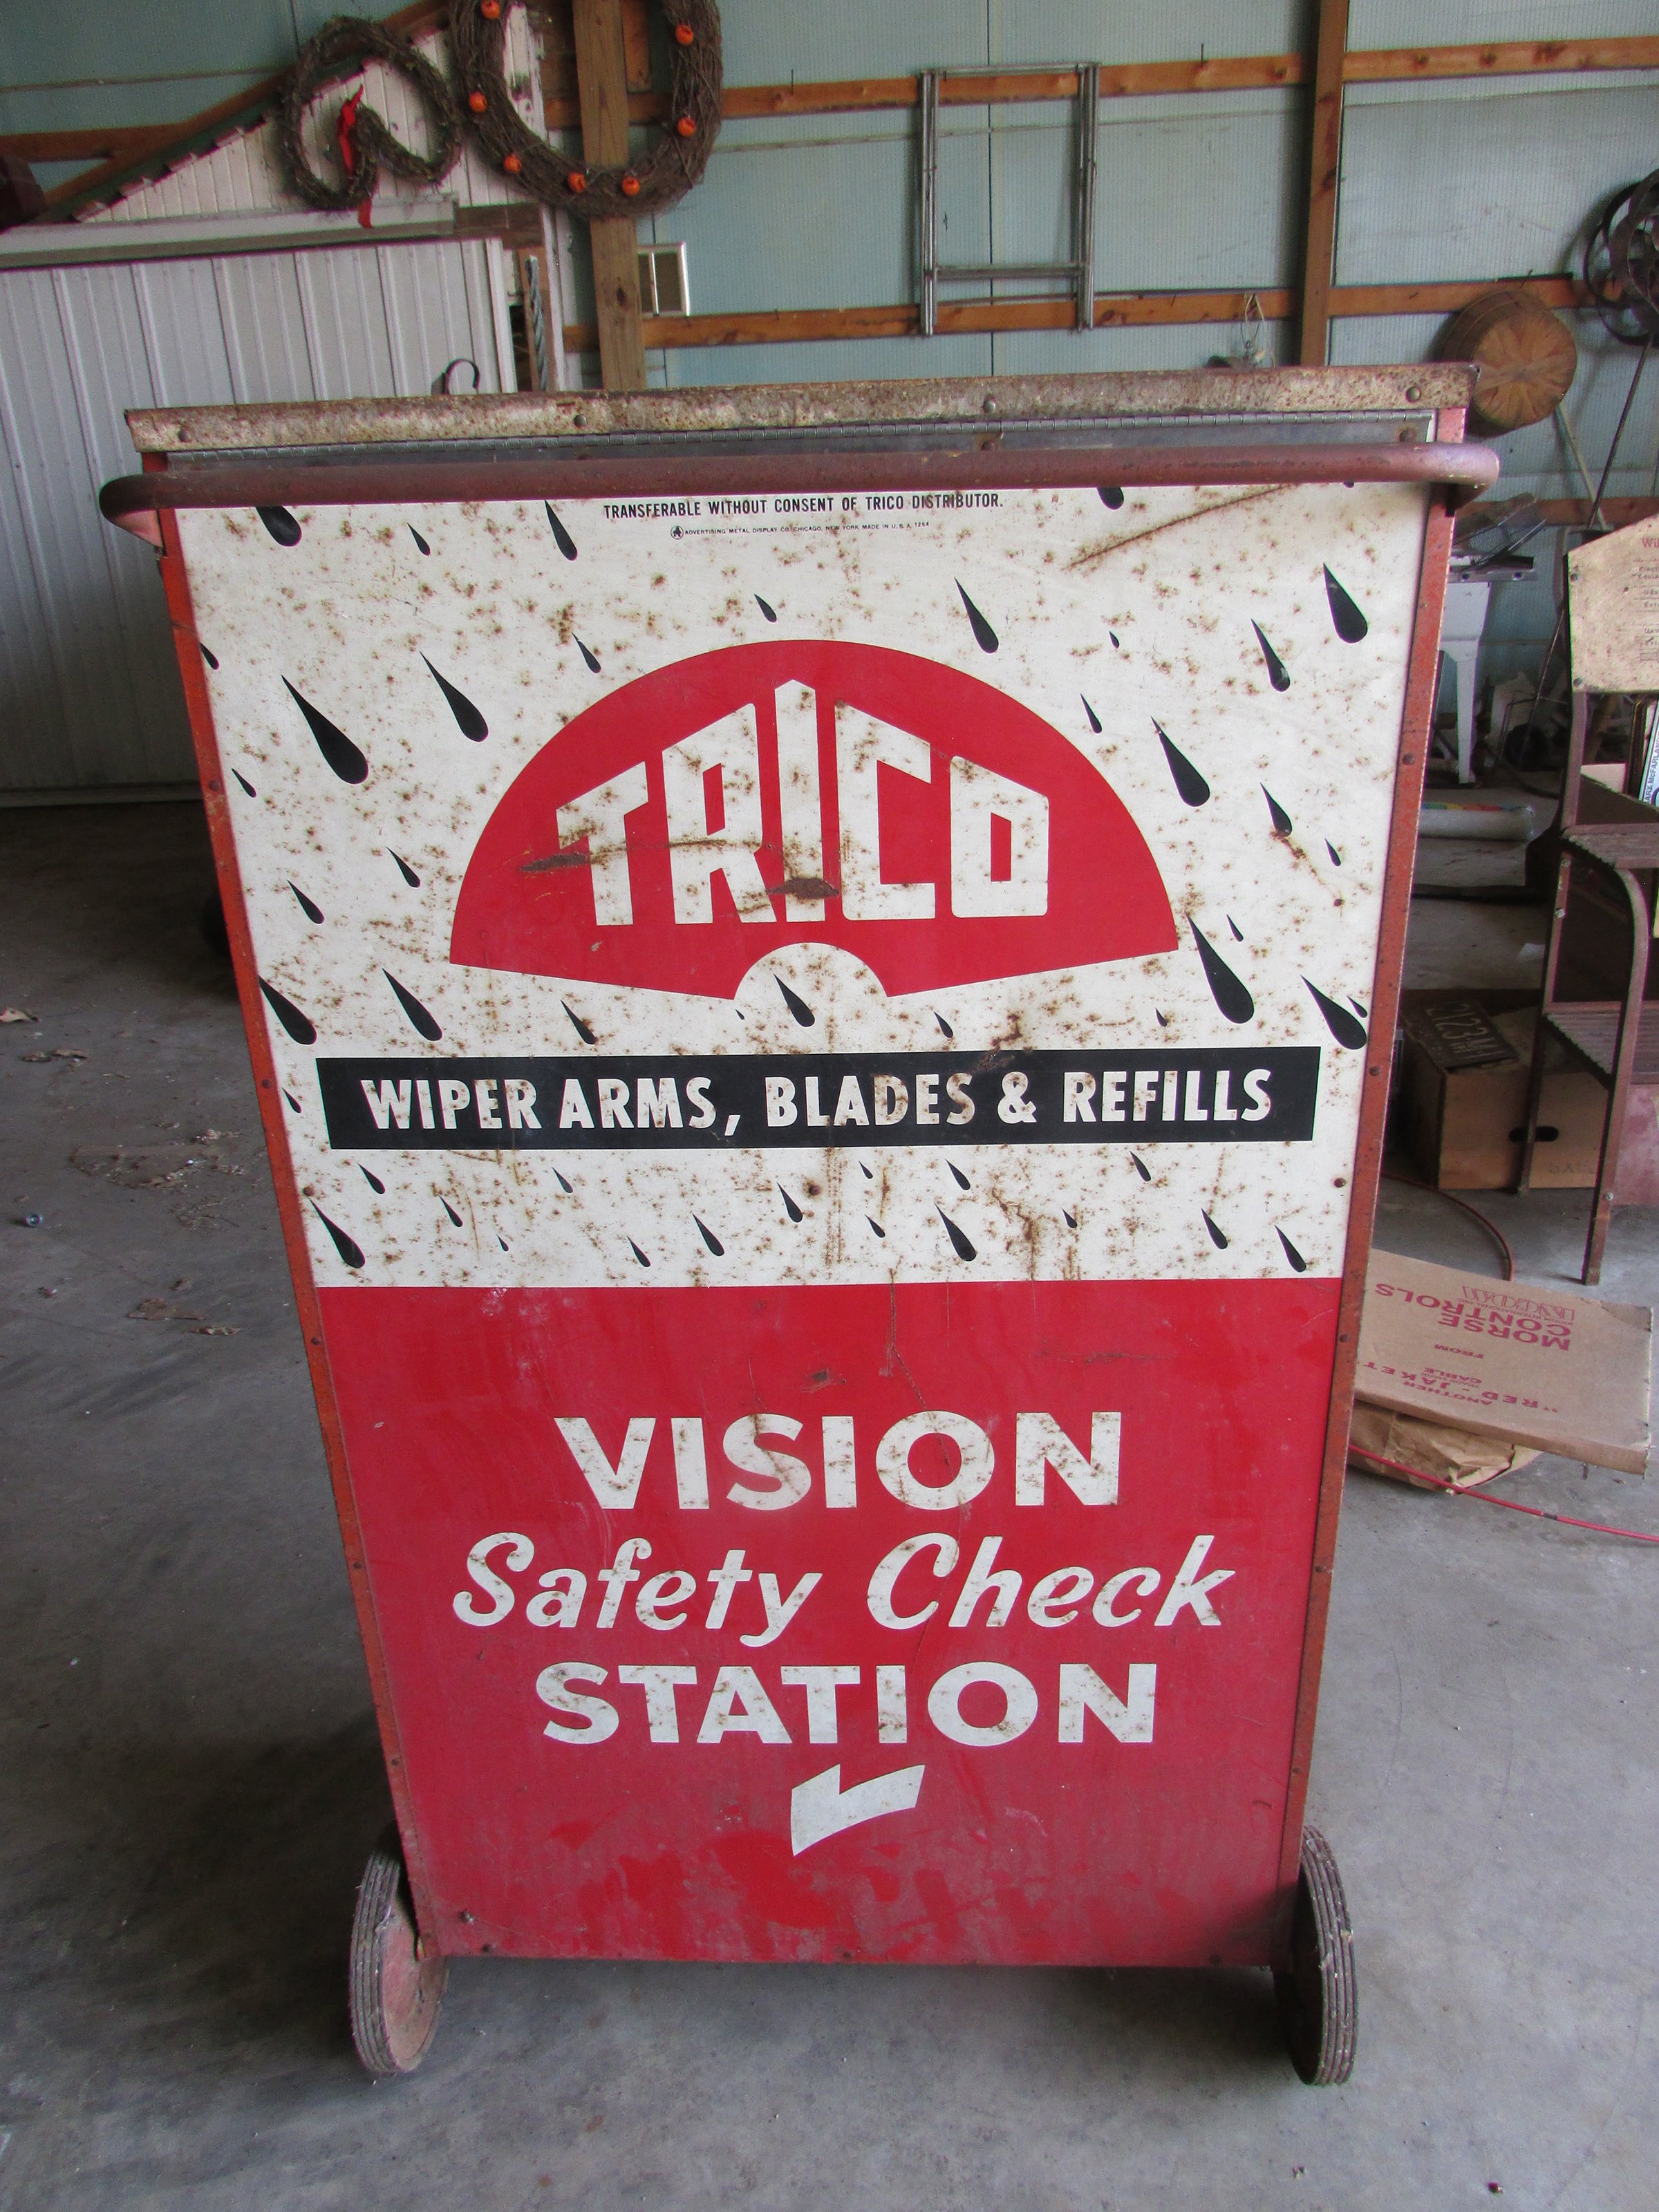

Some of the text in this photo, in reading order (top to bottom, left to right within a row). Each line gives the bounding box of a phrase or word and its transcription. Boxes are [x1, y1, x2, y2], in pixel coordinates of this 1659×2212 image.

[604, 493, 1003, 518] TRANSFERABLE WITHOUT CONSENT OF TRICO DISTRIBUTOR.
[556, 679, 1049, 926] TRICO
[360, 1069, 1271, 1136] WIPER ARMS, BLADES & REFILLS
[1375, 1283, 1571, 1336] CONTROLS
[1438, 1313, 1571, 1351] MORSE
[1424, 1367, 1481, 1383] CABLE
[1434, 1344, 1483, 1359] FROM
[1404, 1381, 1492, 1405] ANOTHER
[554, 1411, 1122, 1512] VISION
[453, 1531, 1236, 1647] Safety Check
[534, 1662, 1156, 1746] STATION
